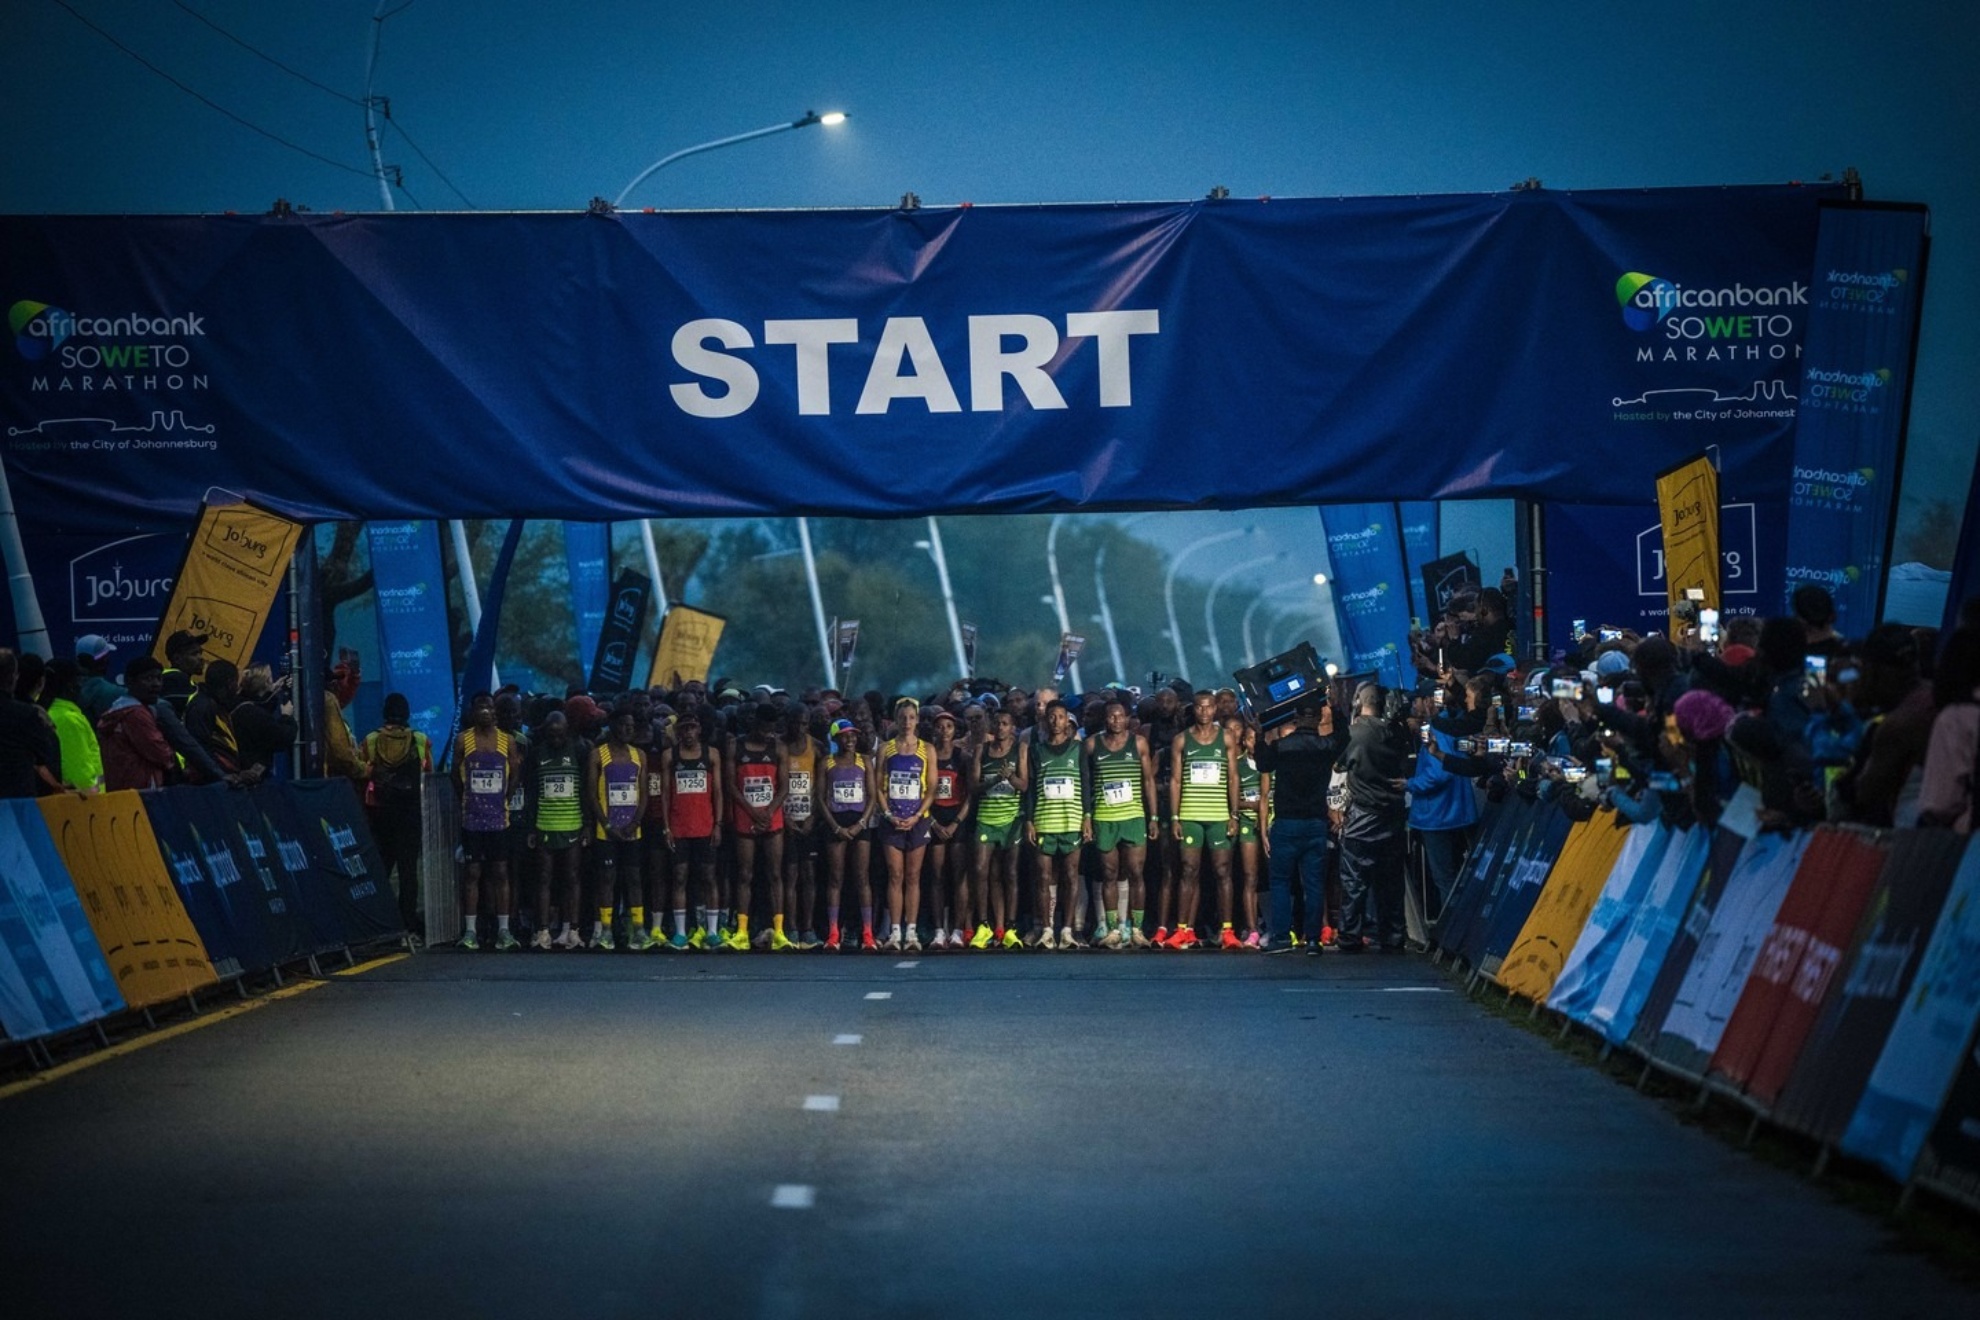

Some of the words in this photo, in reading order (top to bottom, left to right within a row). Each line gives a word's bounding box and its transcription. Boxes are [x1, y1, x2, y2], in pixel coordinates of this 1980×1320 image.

[1635, 281, 1808, 309] africanbank
[29, 312, 206, 337] africanbank
[1665, 314, 1792, 341] SOWETO
[61, 345, 190, 369] SOWETO
[668, 309, 1160, 419] START
[31, 375, 208, 392] MARATHON
[1613, 412, 1654, 422] Hosted
[1656, 411, 1671, 423] by
[1673, 411, 1692, 421] the
[1694, 409, 1718, 422] City
[1719, 409, 1731, 419] of
[9, 441, 51, 452] Hosted
[55, 440, 69, 452] by
[70, 440, 90, 450] the
[92, 440, 116, 452] City
[118, 440, 130, 450] of
[132, 439, 217, 452] Johannesburg
[222, 525, 268, 558] Joburg
[1640, 608, 1646, 617] a
[1648, 607, 1670, 617] worl
[1739, 606, 1757, 617] city
[113, 633, 135, 643] class
[481, 780, 492, 789] 14
[553, 784, 565, 793] 28
[683, 780, 704, 789] 1250
[1056, 785, 1061, 794] 1
[844, 789, 855, 798] 64
[898, 786, 909, 795] 61
[1113, 789, 1122, 798] 11
[621, 792, 628, 801] 9
[751, 793, 771, 803] 1258
